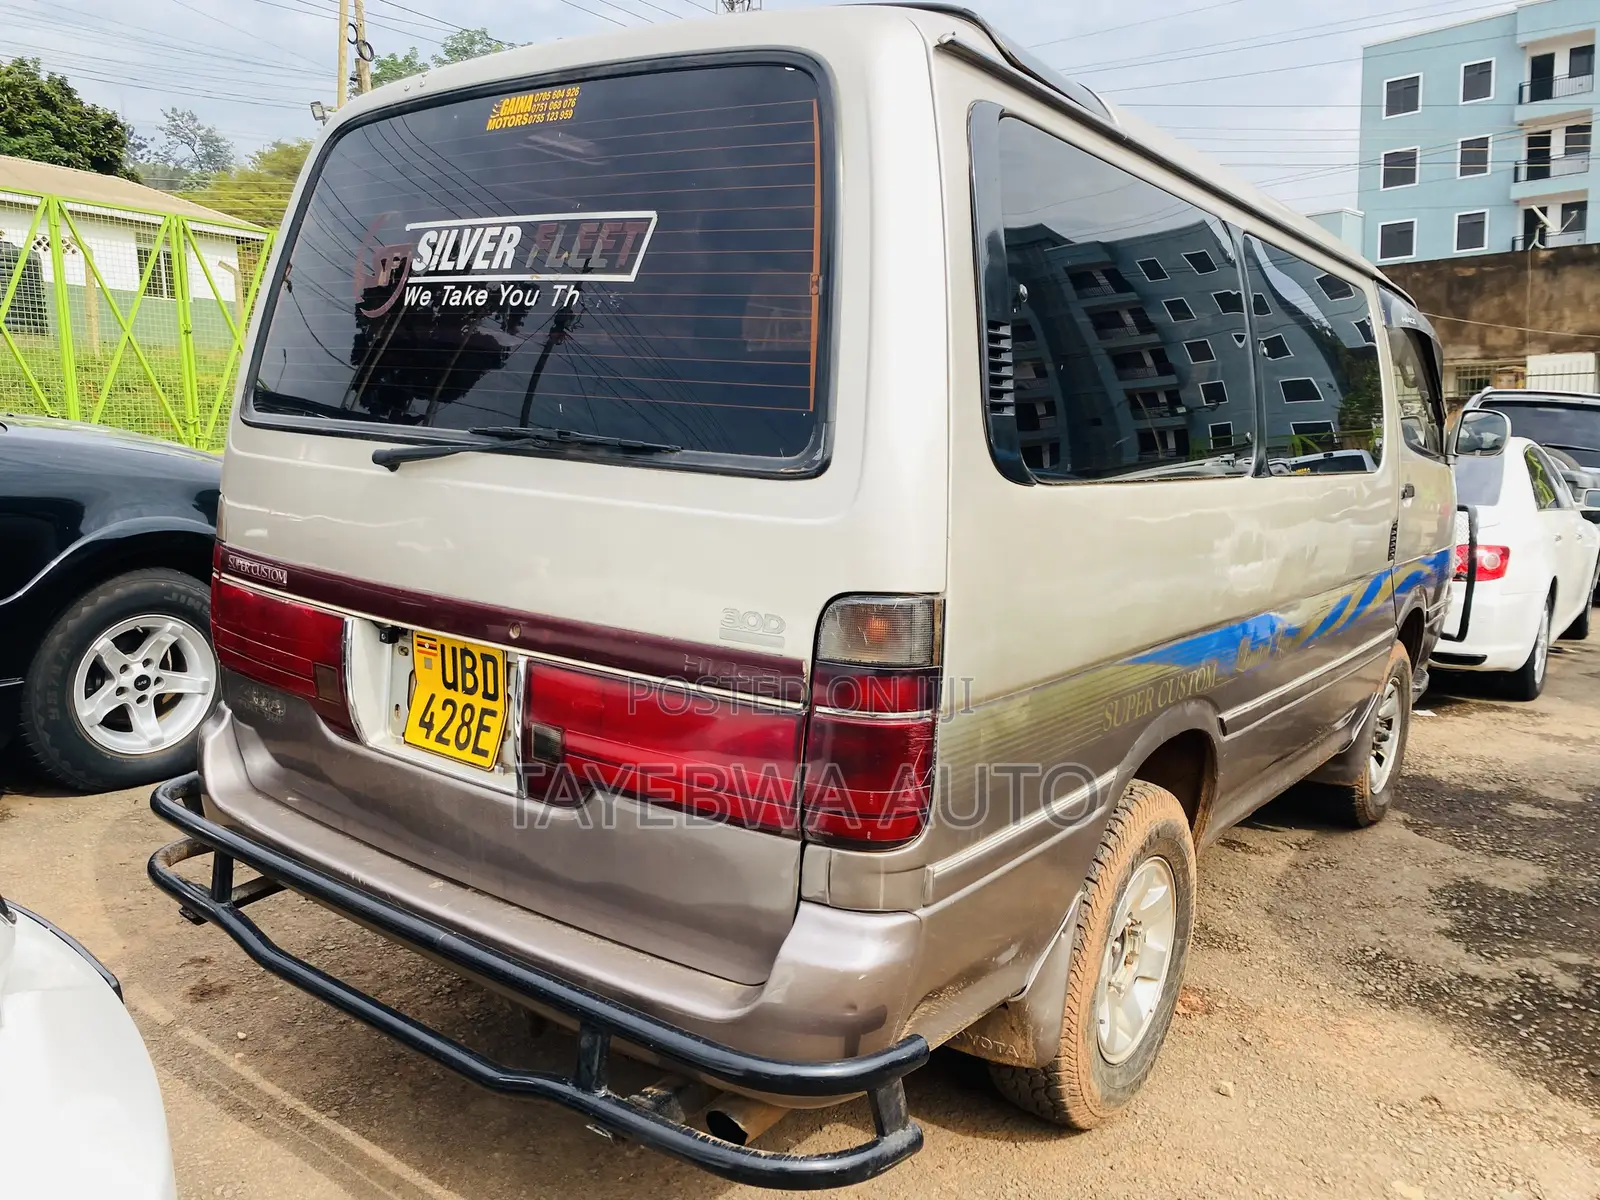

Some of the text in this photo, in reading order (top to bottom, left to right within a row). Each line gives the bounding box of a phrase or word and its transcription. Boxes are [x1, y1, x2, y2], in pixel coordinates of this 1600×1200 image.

[500, 94, 534, 116] GAINA
[562, 98, 577, 108] 076
[486, 113, 530, 131] MOTORS
[528, 109, 573, 124] 0755 123 959
[411, 222, 649, 271] SILVER FLEET
[404, 285, 432, 307] We
[440, 284, 488, 307] Take
[498, 284, 541, 307] You
[228, 555, 288, 584] SUPER CUSTOM
[440, 643, 499, 702] UBD
[1101, 663, 1218, 732] SUPER CUSTOM
[418, 693, 498, 758] 428E
